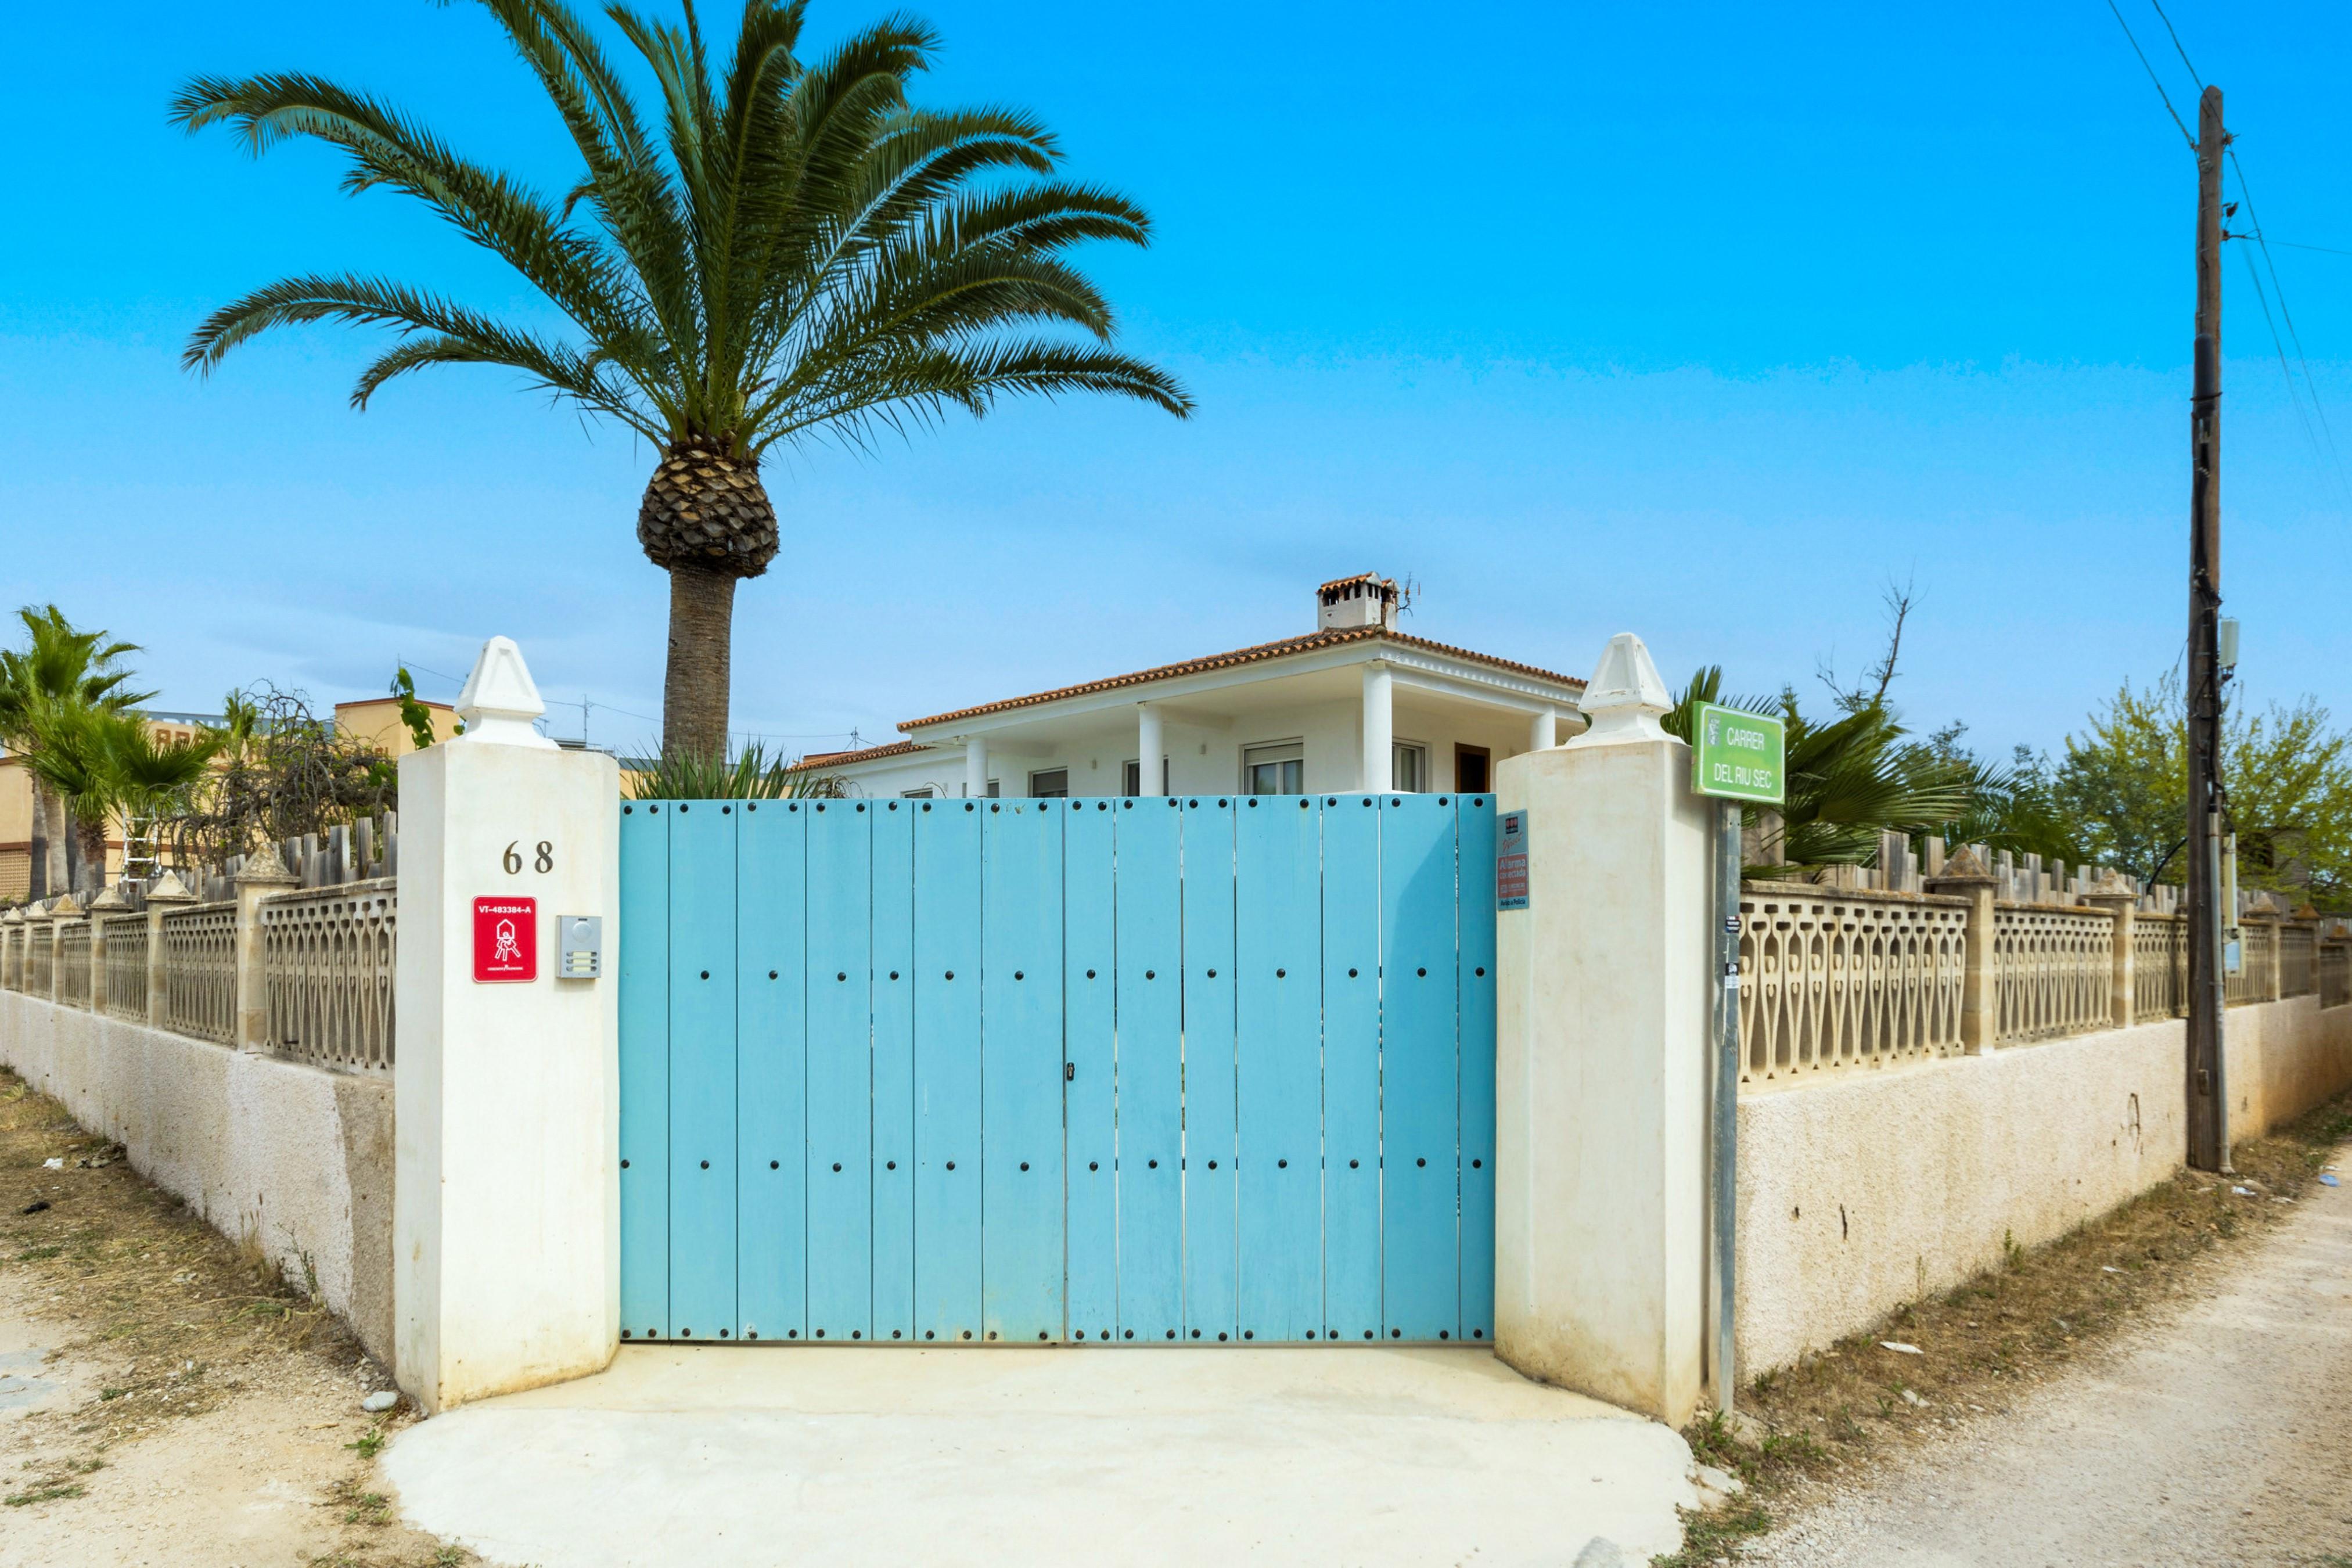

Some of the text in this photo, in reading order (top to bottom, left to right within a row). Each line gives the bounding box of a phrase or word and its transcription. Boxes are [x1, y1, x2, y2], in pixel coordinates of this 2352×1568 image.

[1727, 727, 1765, 750] CARRER
[1714, 763, 1772, 789] DEL RIU SEC
[502, 840, 553, 875] 68
[1500, 859, 1526, 870] Alarma
